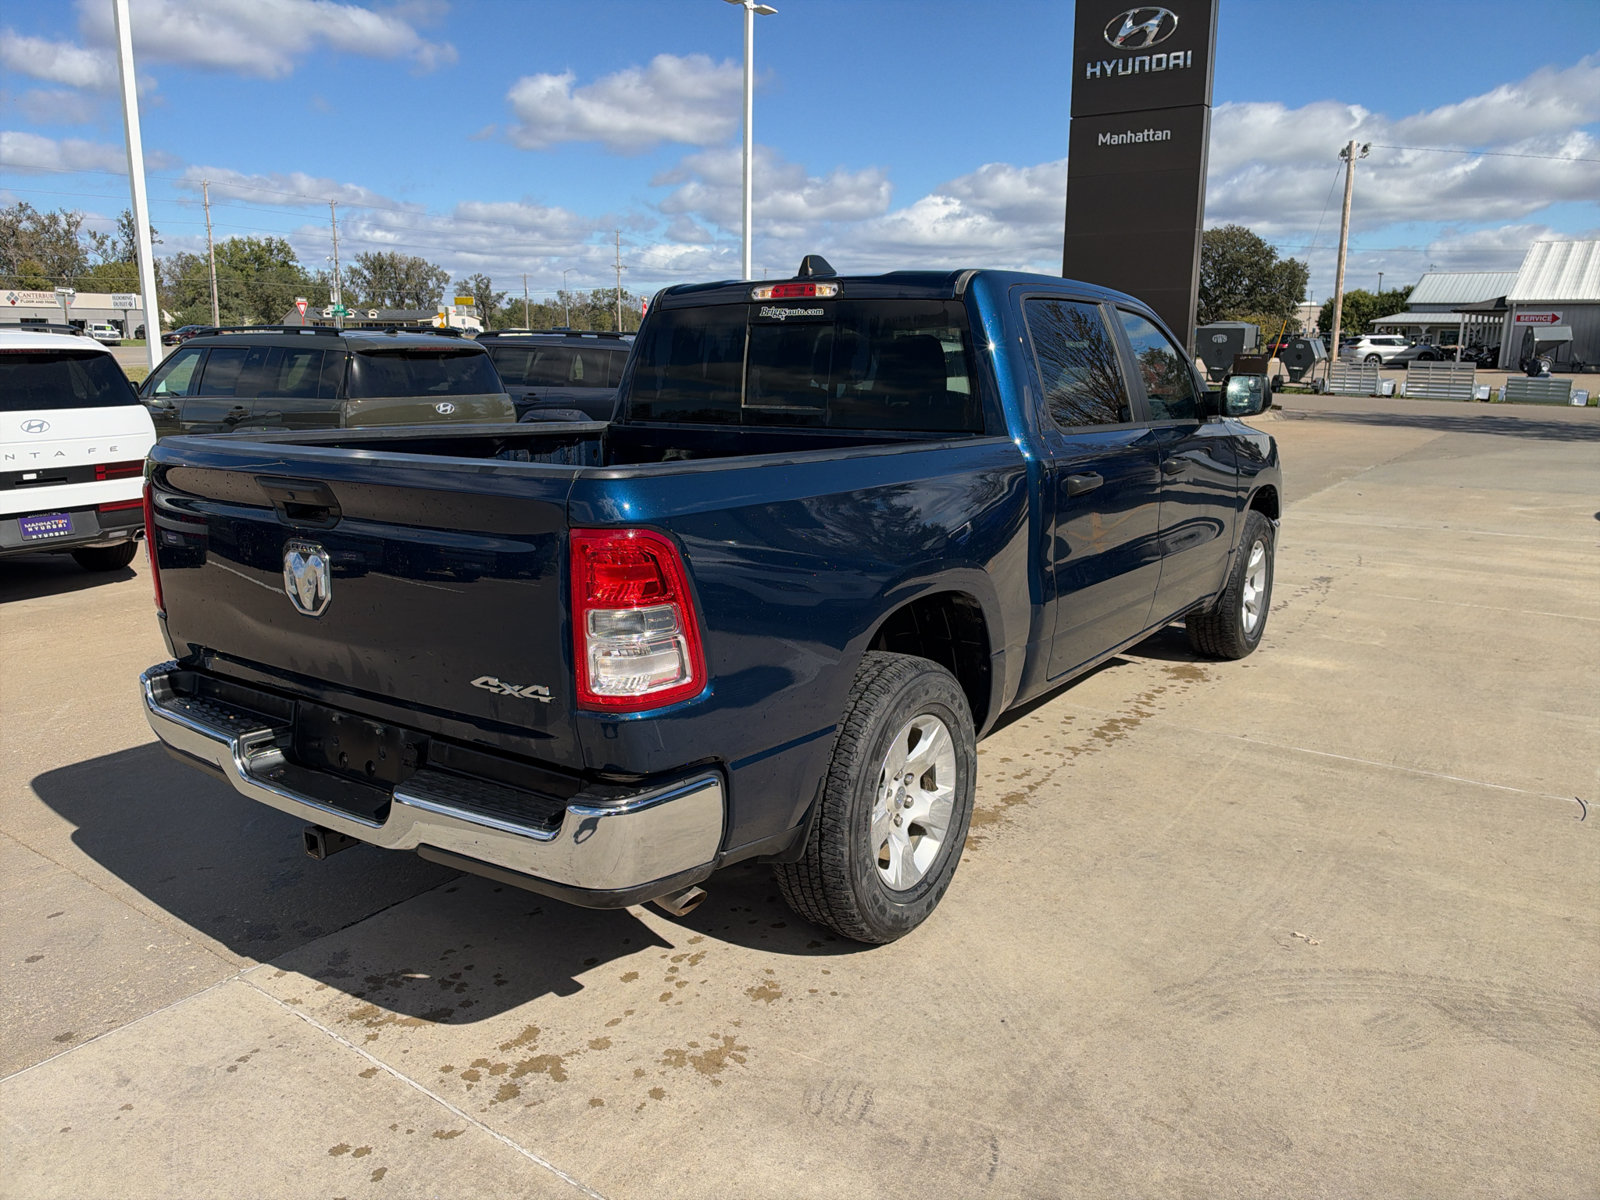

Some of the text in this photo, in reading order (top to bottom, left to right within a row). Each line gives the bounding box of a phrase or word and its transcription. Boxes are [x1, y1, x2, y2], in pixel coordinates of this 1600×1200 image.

[1086, 50, 1192, 79] HYUNDAI
[1098, 128, 1171, 146] Manhattan
[760, 306, 824, 320] Briggsauto.com
[4, 445, 118, 461] NTA FE
[24, 519, 68, 528] MANHATTN
[27, 523, 66, 532] HYUNDAI
